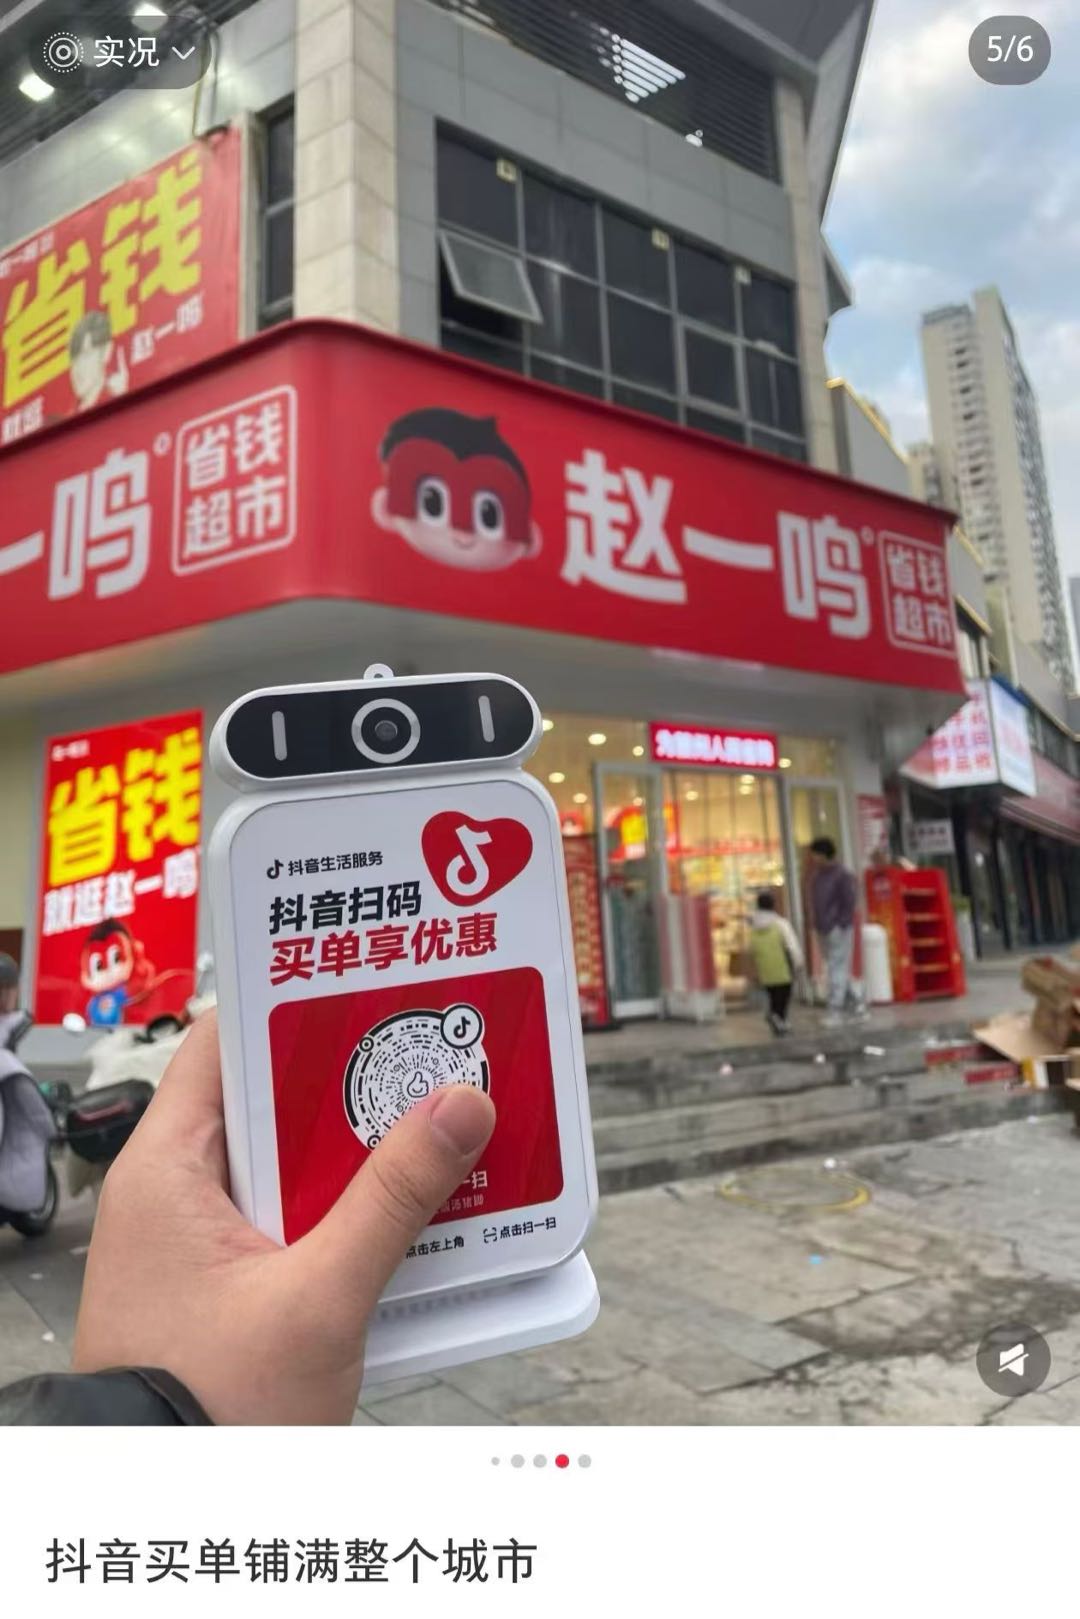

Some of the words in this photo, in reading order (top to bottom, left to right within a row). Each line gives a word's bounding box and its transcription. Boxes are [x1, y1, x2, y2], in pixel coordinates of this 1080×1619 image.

[186, 400, 283, 491] 省钱
[182, 474, 286, 559] 超市
[560, 448, 872, 640] 赵一鸣
[886, 543, 946, 599] 省钱
[892, 593, 953, 645] 超市
[49, 726, 202, 887] 省钱
[288, 850, 384, 877] 抖音生活服务
[269, 880, 422, 935] 抖音扫码
[269, 912, 498, 986] 买单享优惠
[405, 1235, 465, 1259] 点击左上角
[499, 1216, 557, 1239] 点击扫一扫
